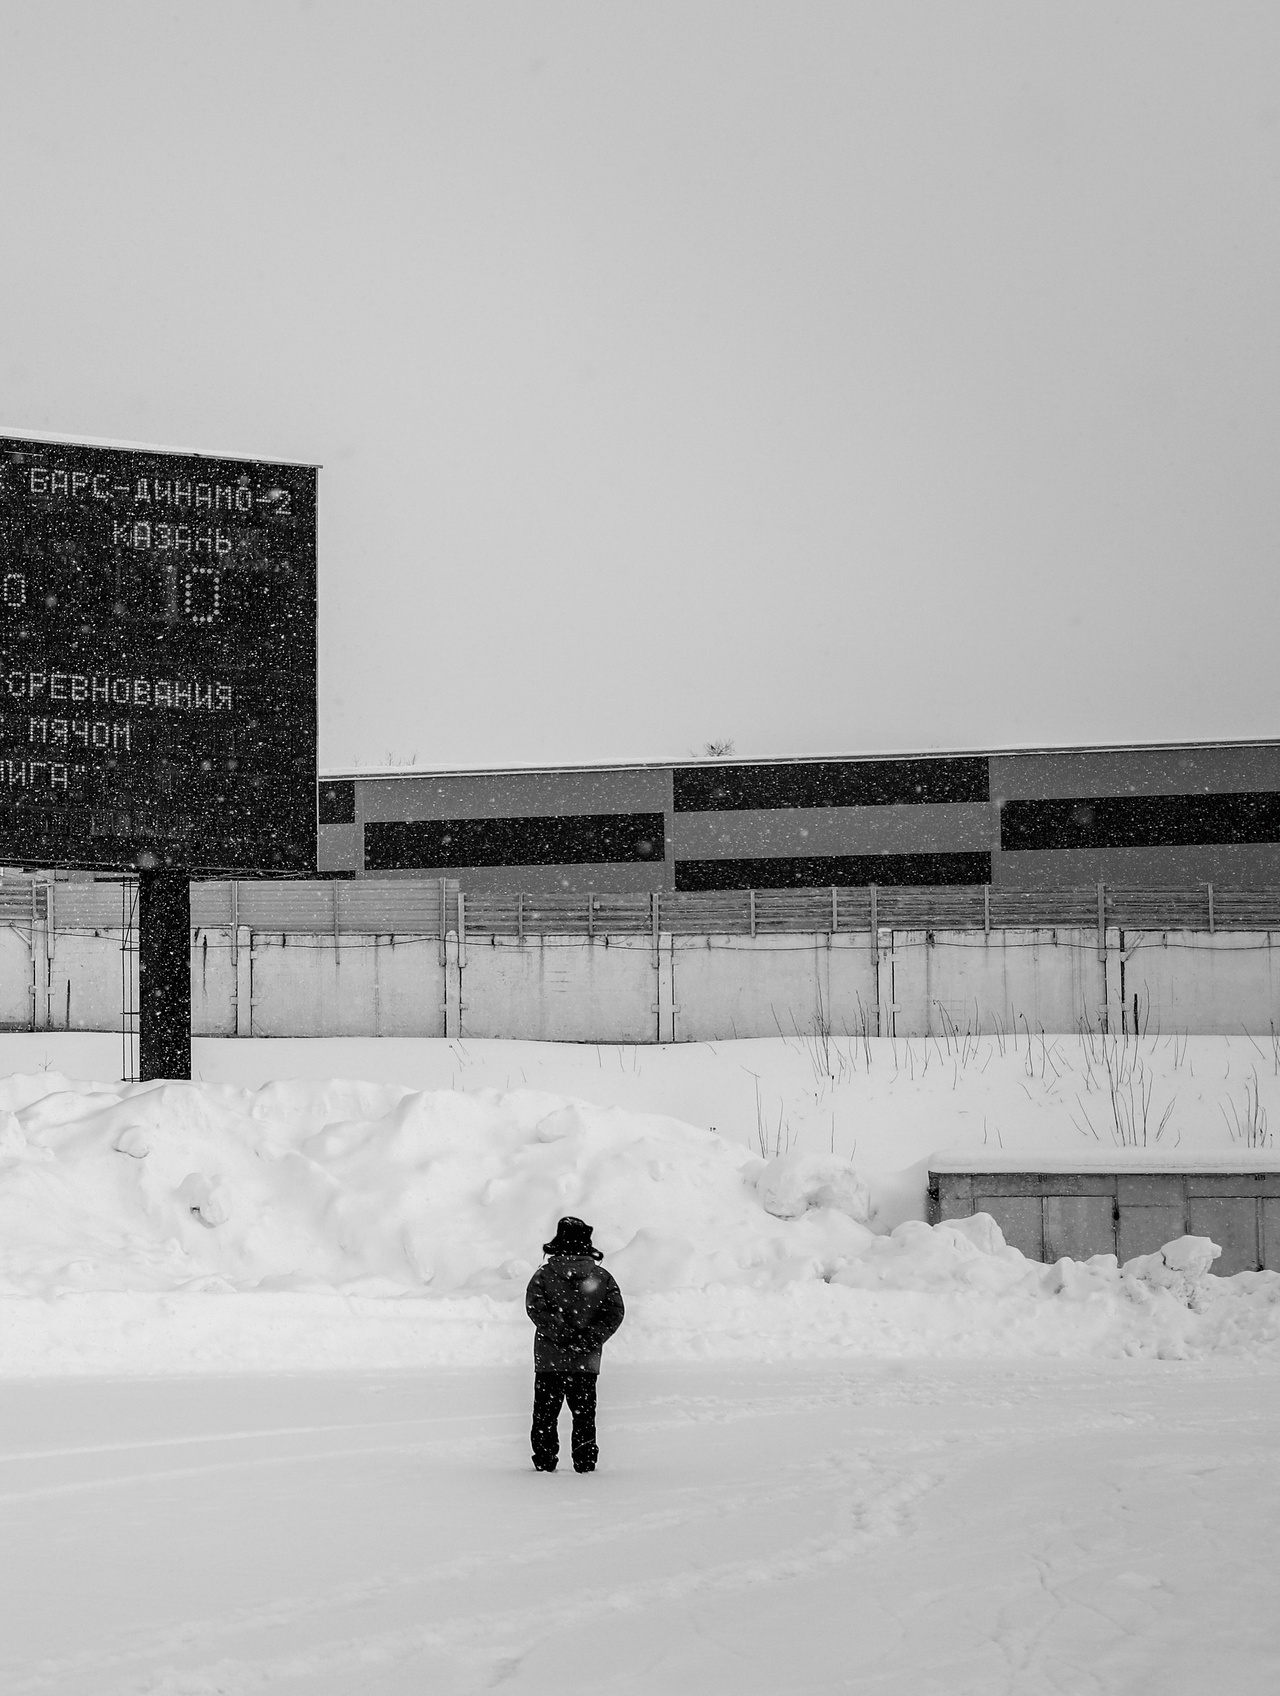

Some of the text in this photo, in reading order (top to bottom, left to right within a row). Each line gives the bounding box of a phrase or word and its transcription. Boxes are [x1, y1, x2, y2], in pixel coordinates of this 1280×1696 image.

[112, 519, 233, 554] КАЗАНЬ
[184, 566, 220, 623] 0
[29, 716, 131, 751] МЯЧОМ
